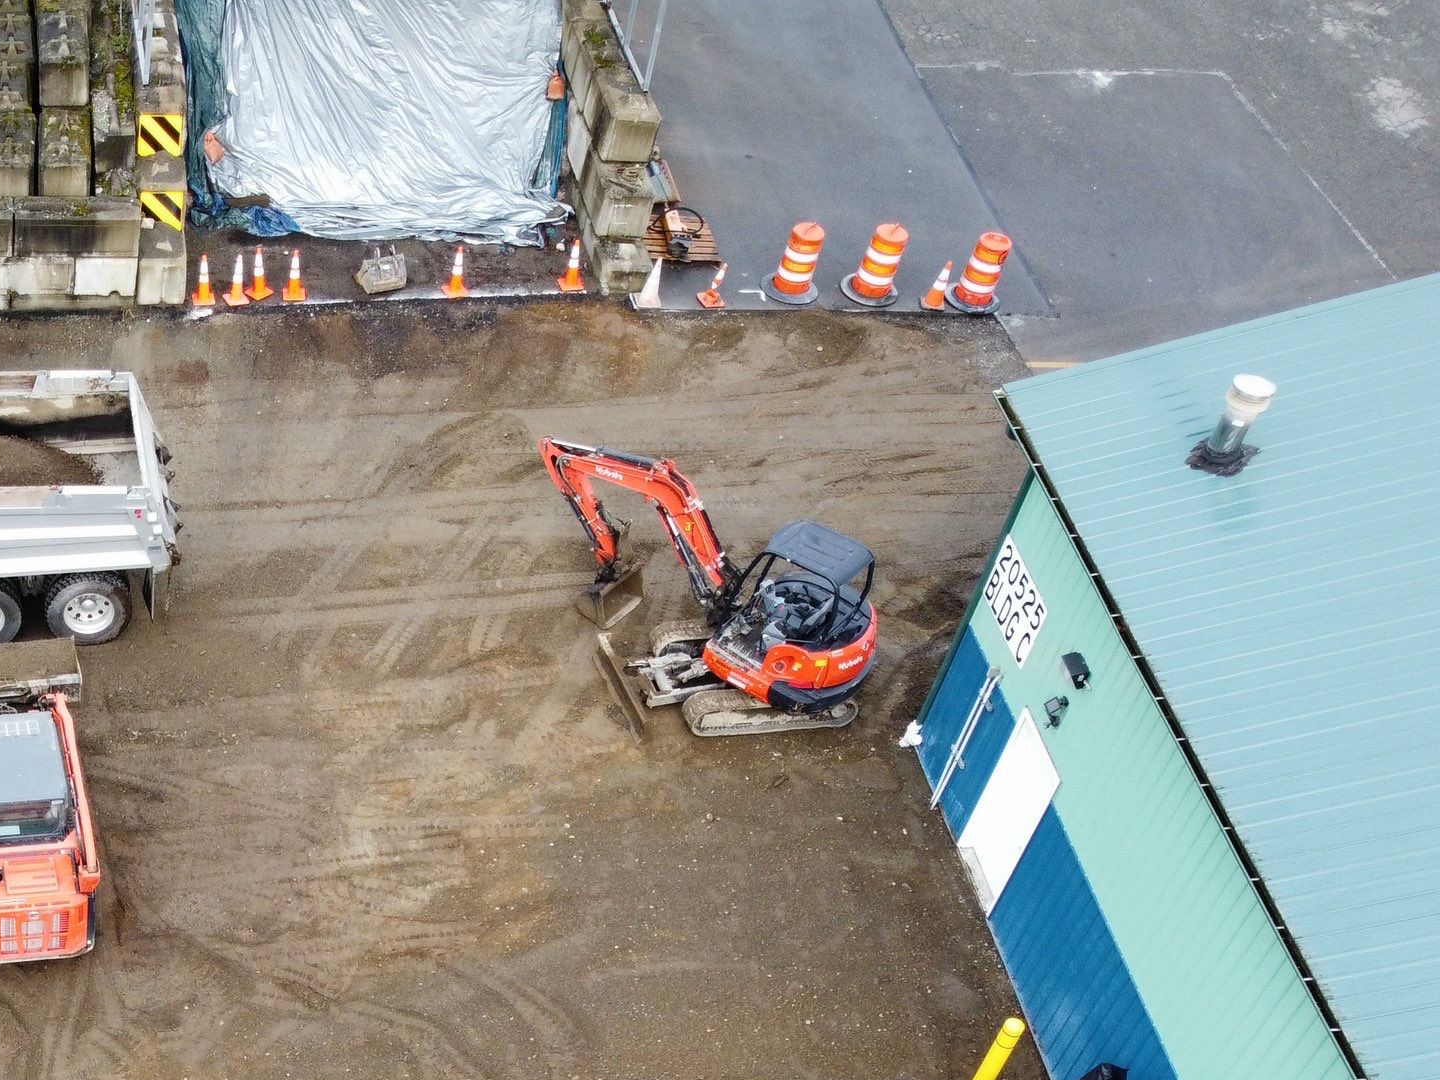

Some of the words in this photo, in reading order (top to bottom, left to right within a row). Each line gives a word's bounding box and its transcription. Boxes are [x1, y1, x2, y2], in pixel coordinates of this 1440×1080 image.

[595, 465, 624, 481] Kubota
[684, 521, 692, 532] 3
[999, 544, 1044, 631] 20525
[985, 568, 1020, 641] BLDG
[1015, 632, 1031, 663] C
[838, 655, 864, 671] Kubota
